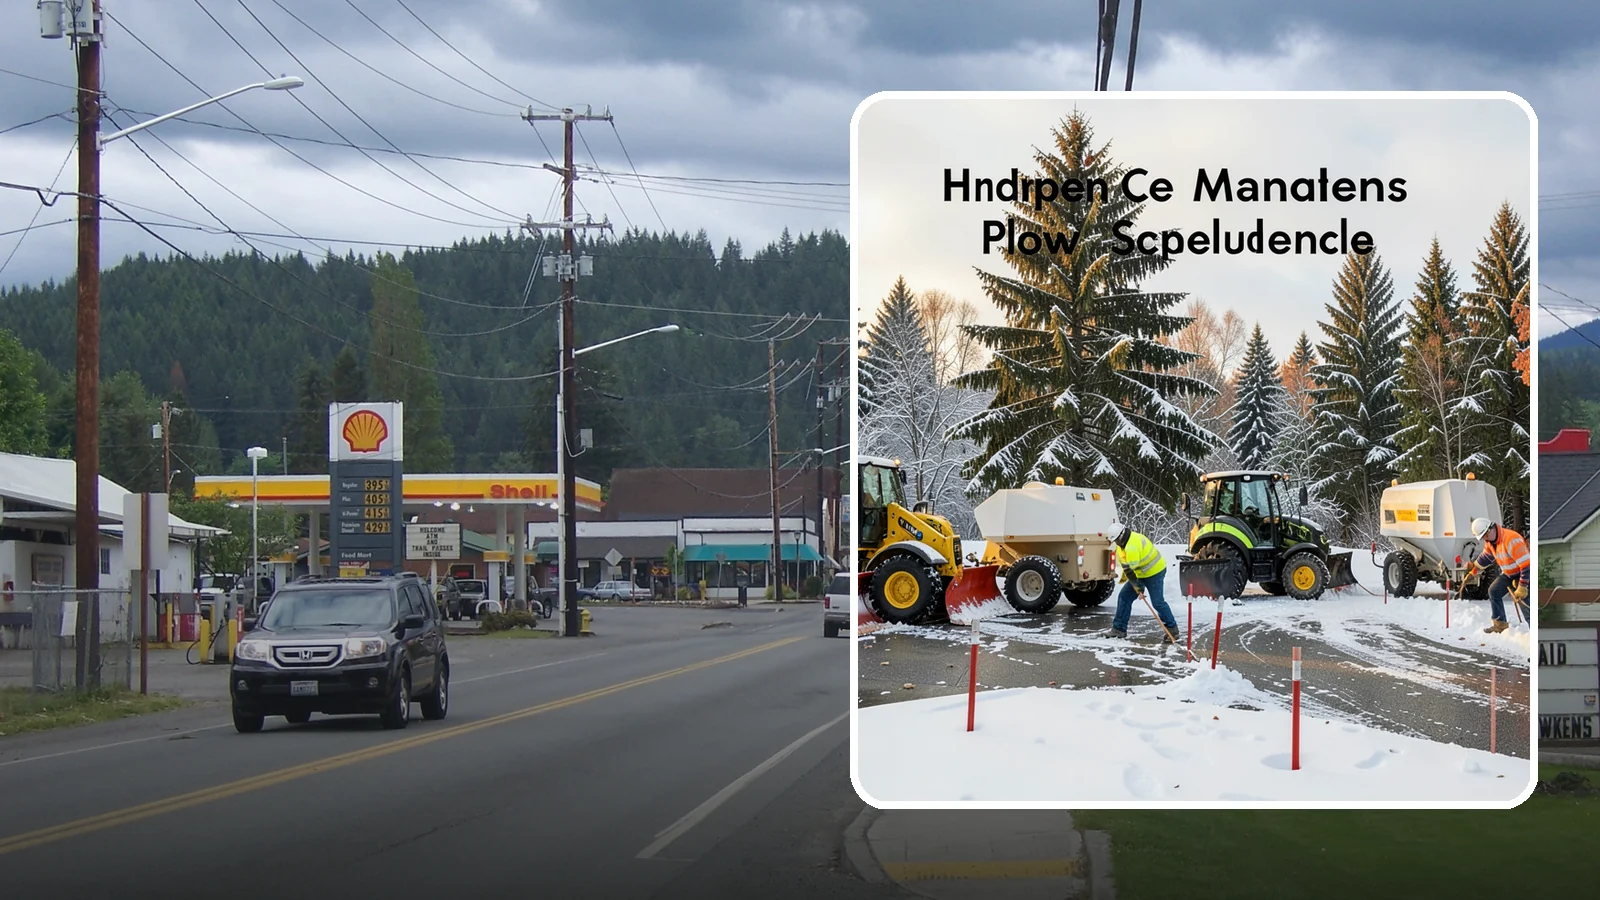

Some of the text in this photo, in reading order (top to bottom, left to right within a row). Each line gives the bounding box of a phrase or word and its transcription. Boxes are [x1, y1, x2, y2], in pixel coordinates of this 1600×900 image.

[366, 480, 383, 490] 395
[490, 484, 547, 498] Shell
[366, 494, 383, 504] 405
[366, 522, 383, 532] 429
